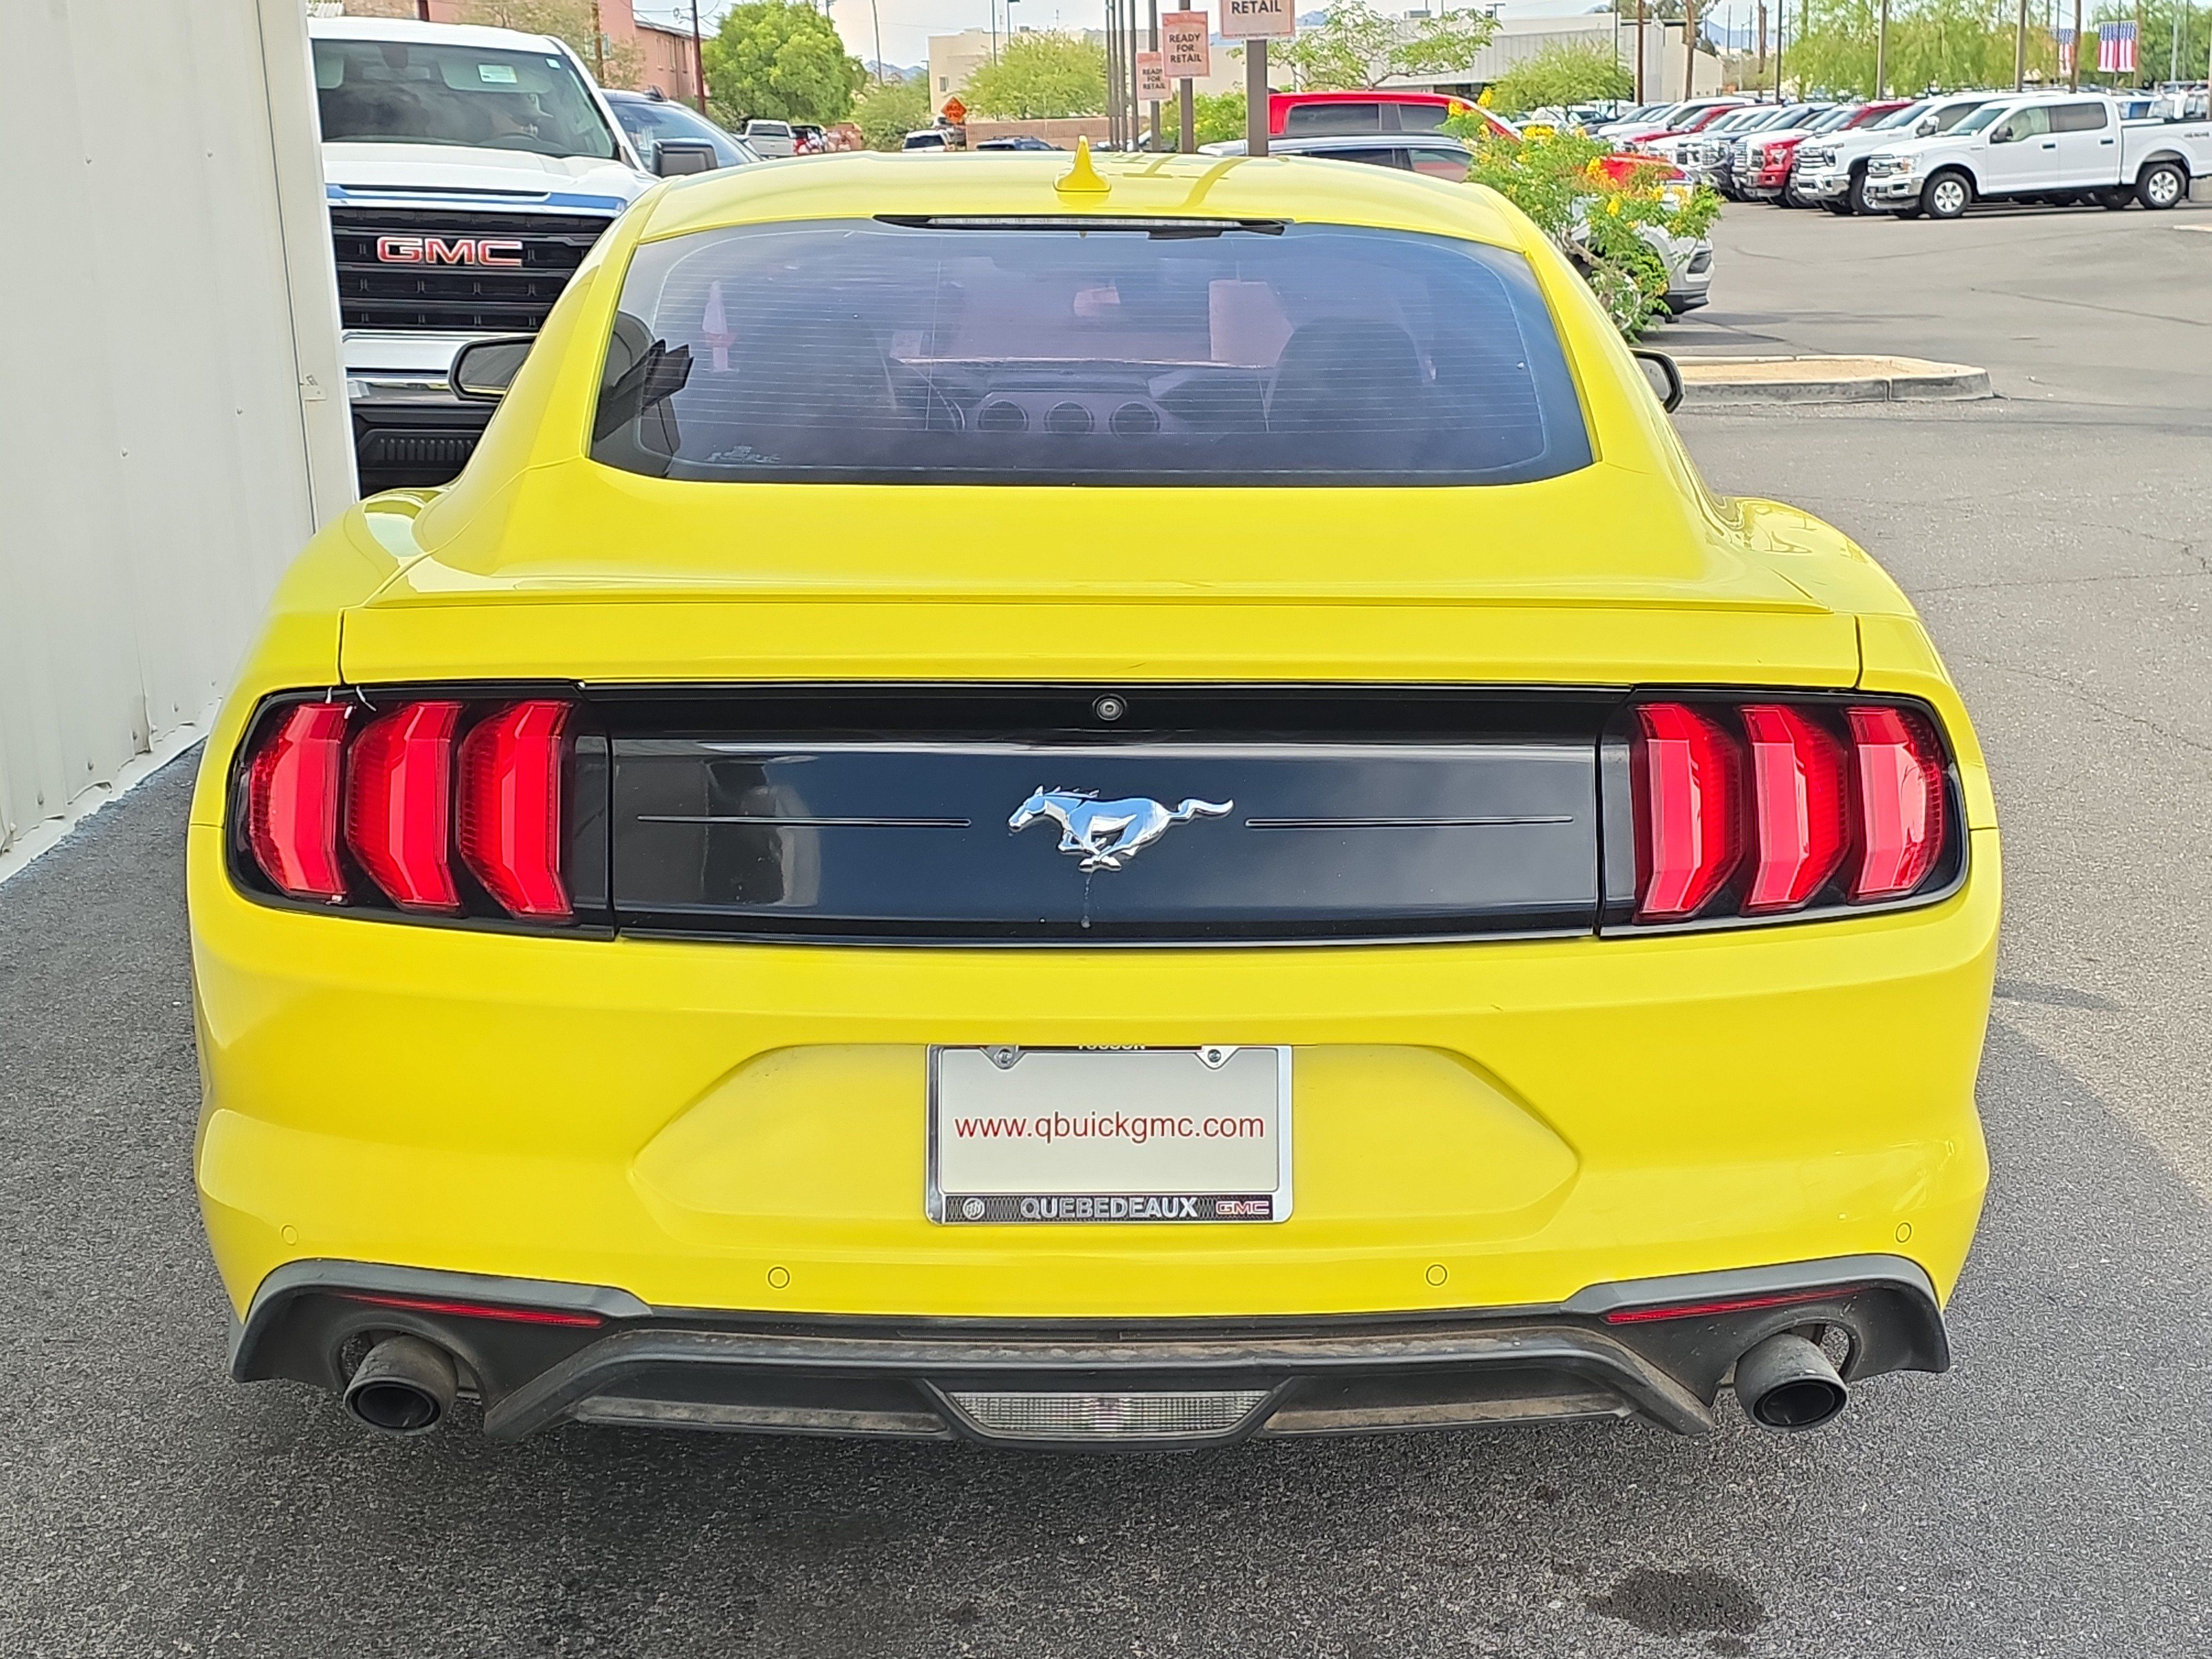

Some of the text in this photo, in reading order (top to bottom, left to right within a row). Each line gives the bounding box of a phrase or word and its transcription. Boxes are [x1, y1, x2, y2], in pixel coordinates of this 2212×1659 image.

[1231, 0, 1282, 14] RETAIL
[1169, 33, 1201, 42] READY
[1176, 44, 1194, 52] FOR
[1170, 54, 1202, 63] RETAIL
[377, 236, 523, 267] GMC
[954, 1111, 1265, 1144] www.qbuickgmc.com
[1020, 1197, 1270, 1220] QUEBEDEAUX GMC
